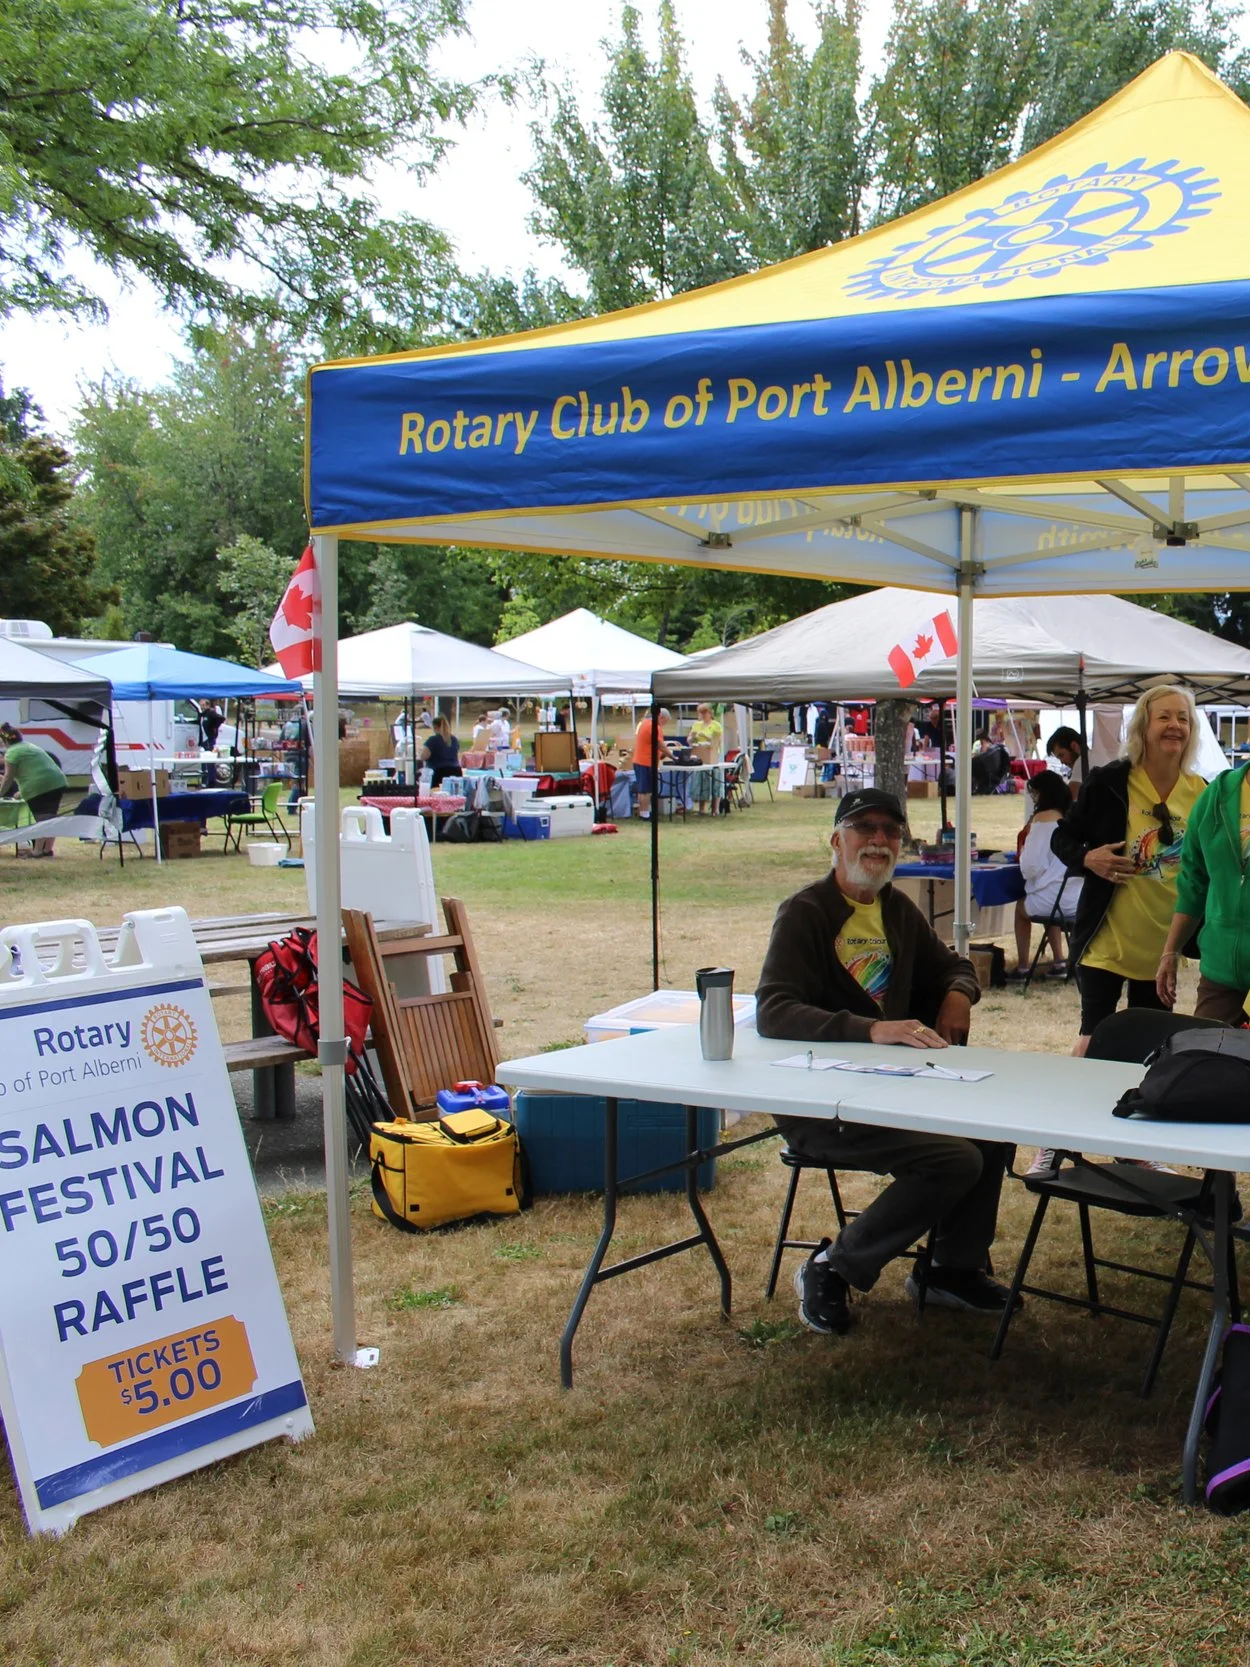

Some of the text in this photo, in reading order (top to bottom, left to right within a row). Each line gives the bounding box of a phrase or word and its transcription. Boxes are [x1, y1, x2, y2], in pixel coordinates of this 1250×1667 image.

[1014, 175, 1148, 208] ROTARY
[399, 408, 540, 456] Rotary
[550, 390, 649, 441] Club
[663, 378, 715, 429] of
[726, 372, 832, 424] Port
[843, 348, 1043, 414] Alberni
[1061, 373, 1081, 381] -
[33, 1020, 131, 1057] Rotary
[13, 1072, 32, 1093] of
[39, 1066, 77, 1088] Port
[83, 1052, 142, 1080] Alberni
[0, 1092, 199, 1170] SALMON
[0, 1146, 225, 1232] FESTIVAL
[55, 1207, 201, 1278] 50/50
[53, 1254, 229, 1342] RAFFLE
[107, 1329, 221, 1384] TICKETS
[121, 1358, 222, 1415] $5.00
